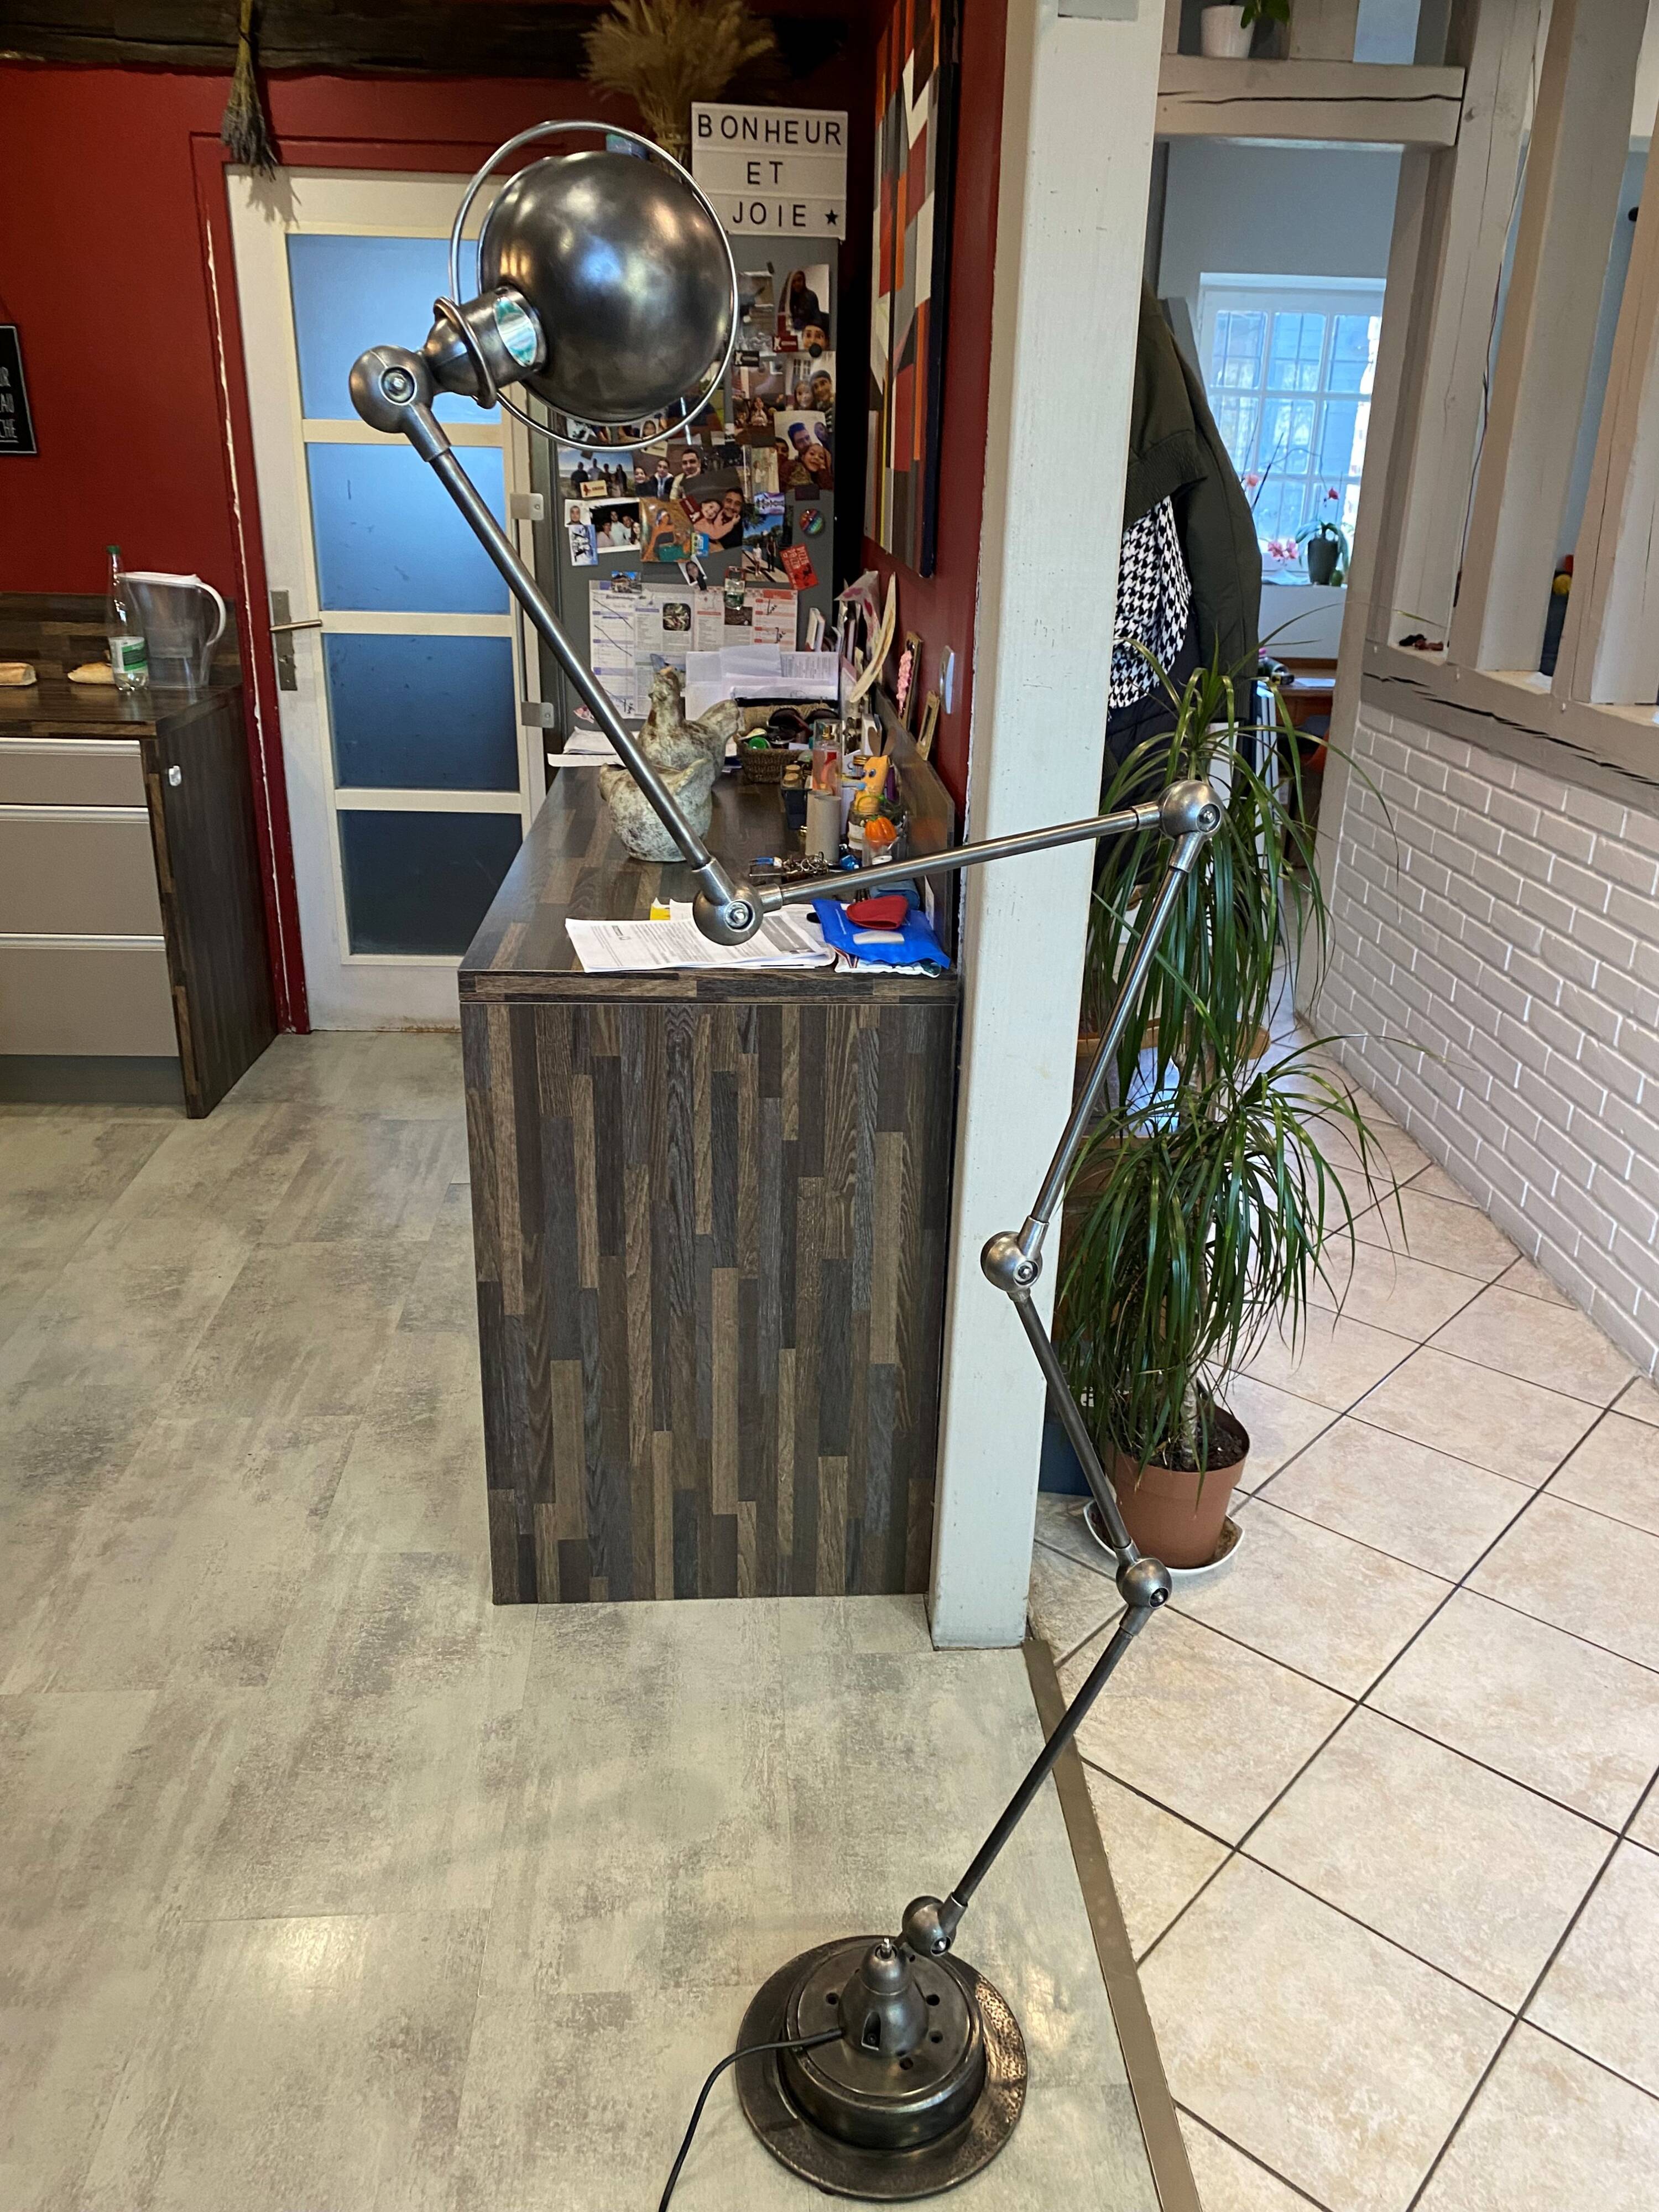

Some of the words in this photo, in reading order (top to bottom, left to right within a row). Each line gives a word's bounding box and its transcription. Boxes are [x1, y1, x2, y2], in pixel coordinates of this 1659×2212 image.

[697, 114, 841, 145] BONHEUR
[747, 161, 784, 185] ET
[732, 201, 806, 227] JOIE
